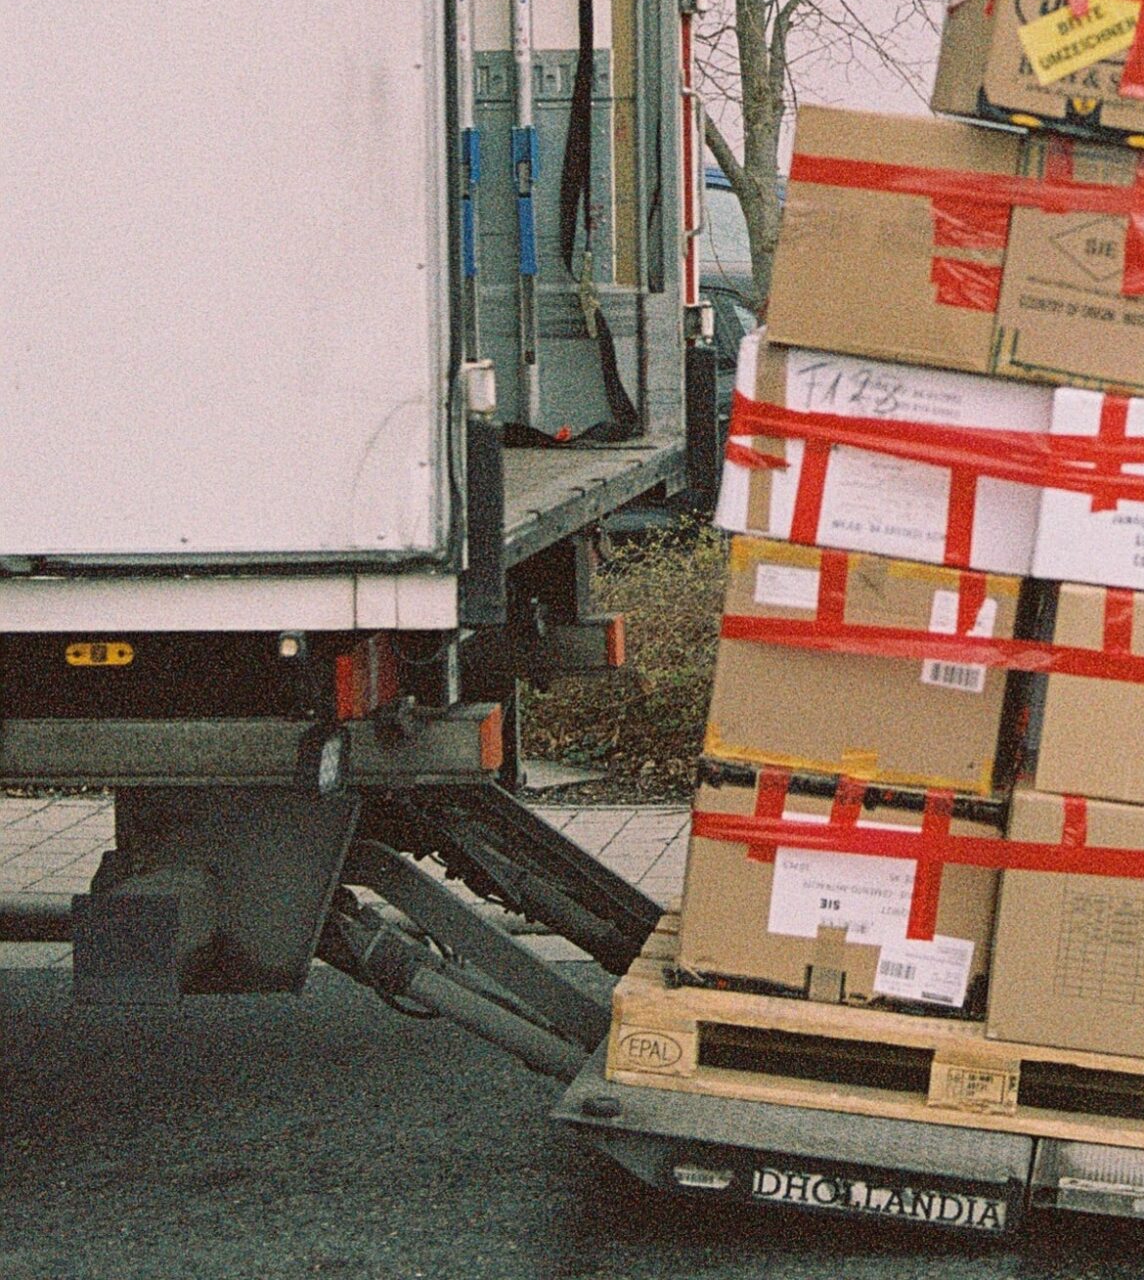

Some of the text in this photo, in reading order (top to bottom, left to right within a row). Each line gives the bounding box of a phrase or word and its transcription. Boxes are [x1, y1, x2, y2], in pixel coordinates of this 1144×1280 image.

[820, 898, 840, 911] SIE
[628, 1037, 669, 1062] EPAL
[754, 1168, 1002, 1229] DHOLLANDIA
